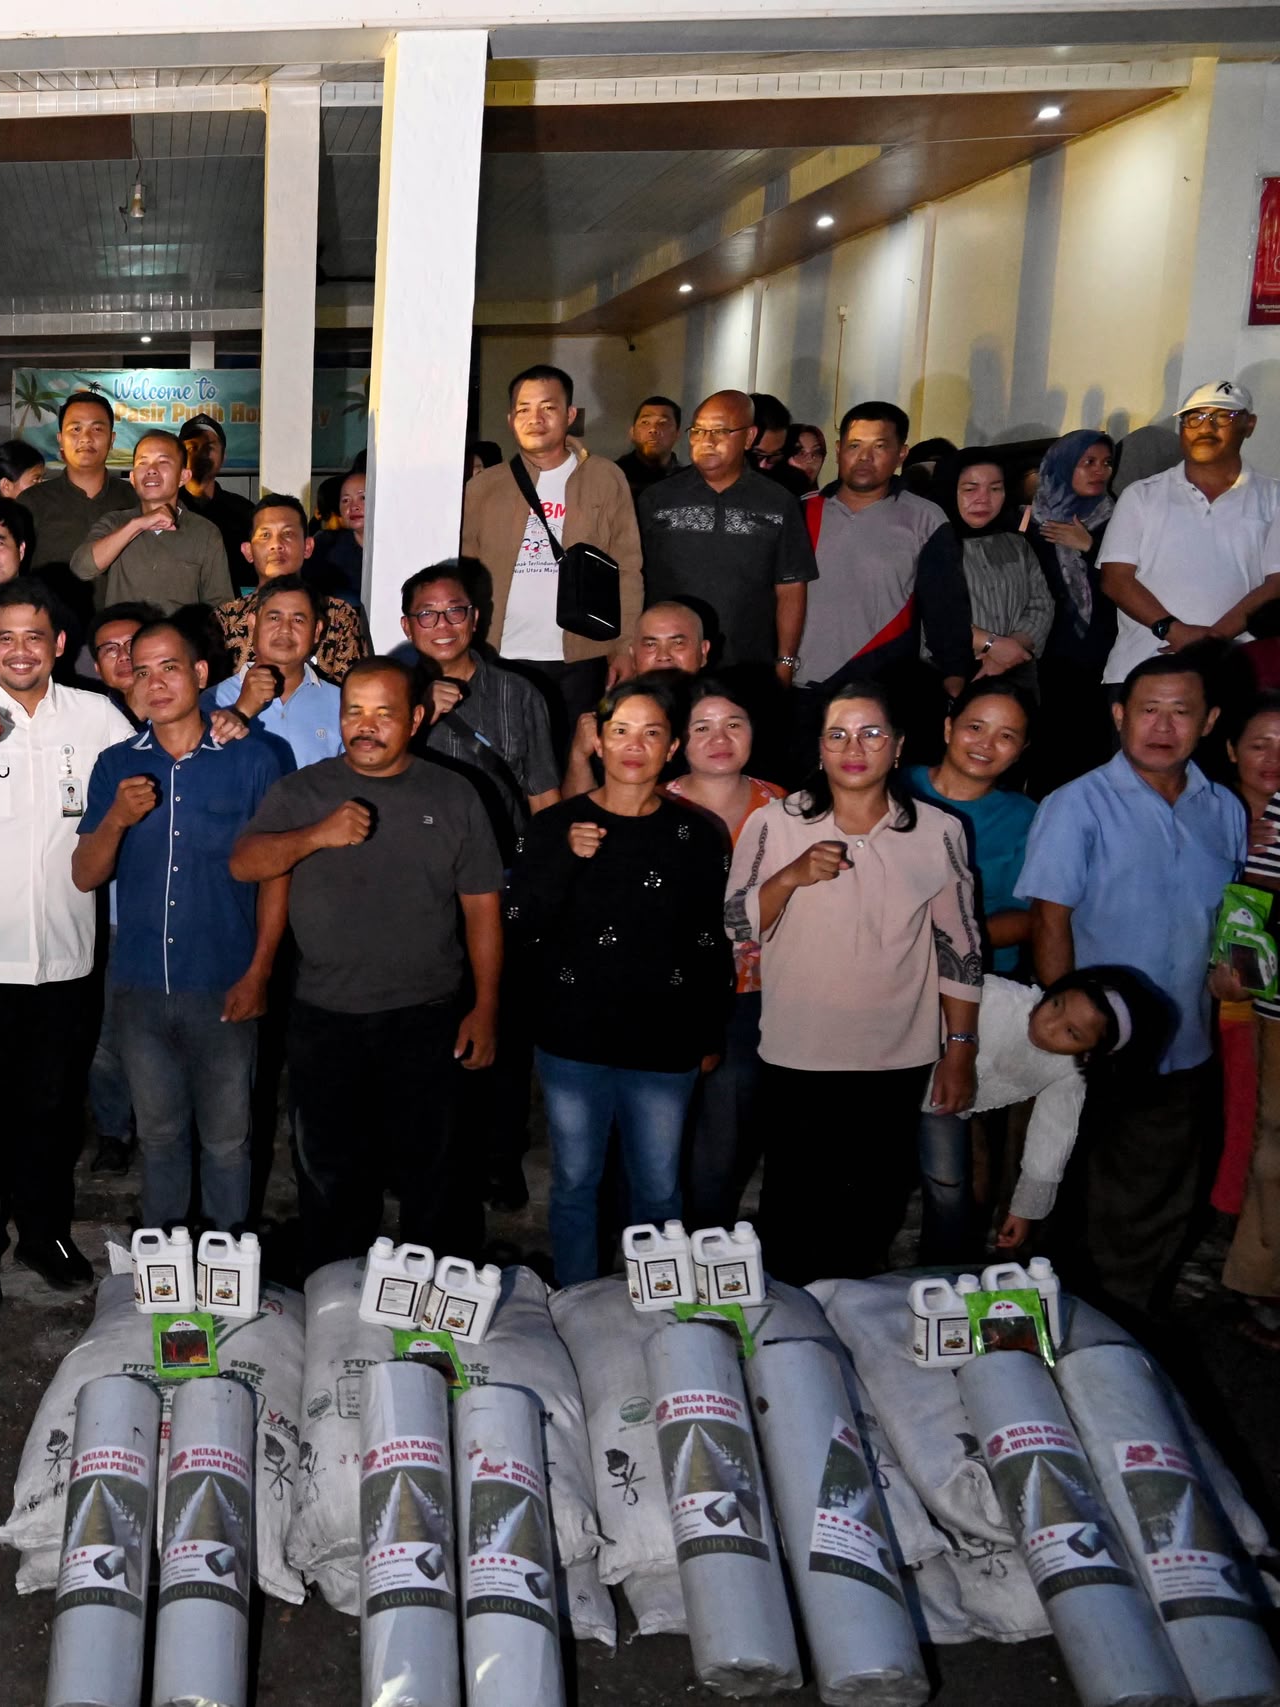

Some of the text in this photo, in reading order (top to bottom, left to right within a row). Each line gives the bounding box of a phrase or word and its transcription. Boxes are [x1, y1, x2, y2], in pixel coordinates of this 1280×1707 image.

[112, 376, 219, 401] Welcome to
[114, 402, 167, 423] Pasir
[171, 402, 224, 424] Putih
[672, 1394, 742, 1412] MULSA PLASTIK
[673, 1405, 737, 1420] HITAM PERAK
[1006, 1425, 1041, 1439] MULSA
[411, 1440, 444, 1453] PLASTIK
[1010, 1437, 1045, 1450] HITAM
[82, 1450, 146, 1468] MULSA PLASTIK
[191, 1447, 221, 1458] MULSA
[411, 1452, 440, 1465] PERAK
[82, 1461, 139, 1476] HITAM PERAK
[191, 1458, 221, 1468] HITAM
